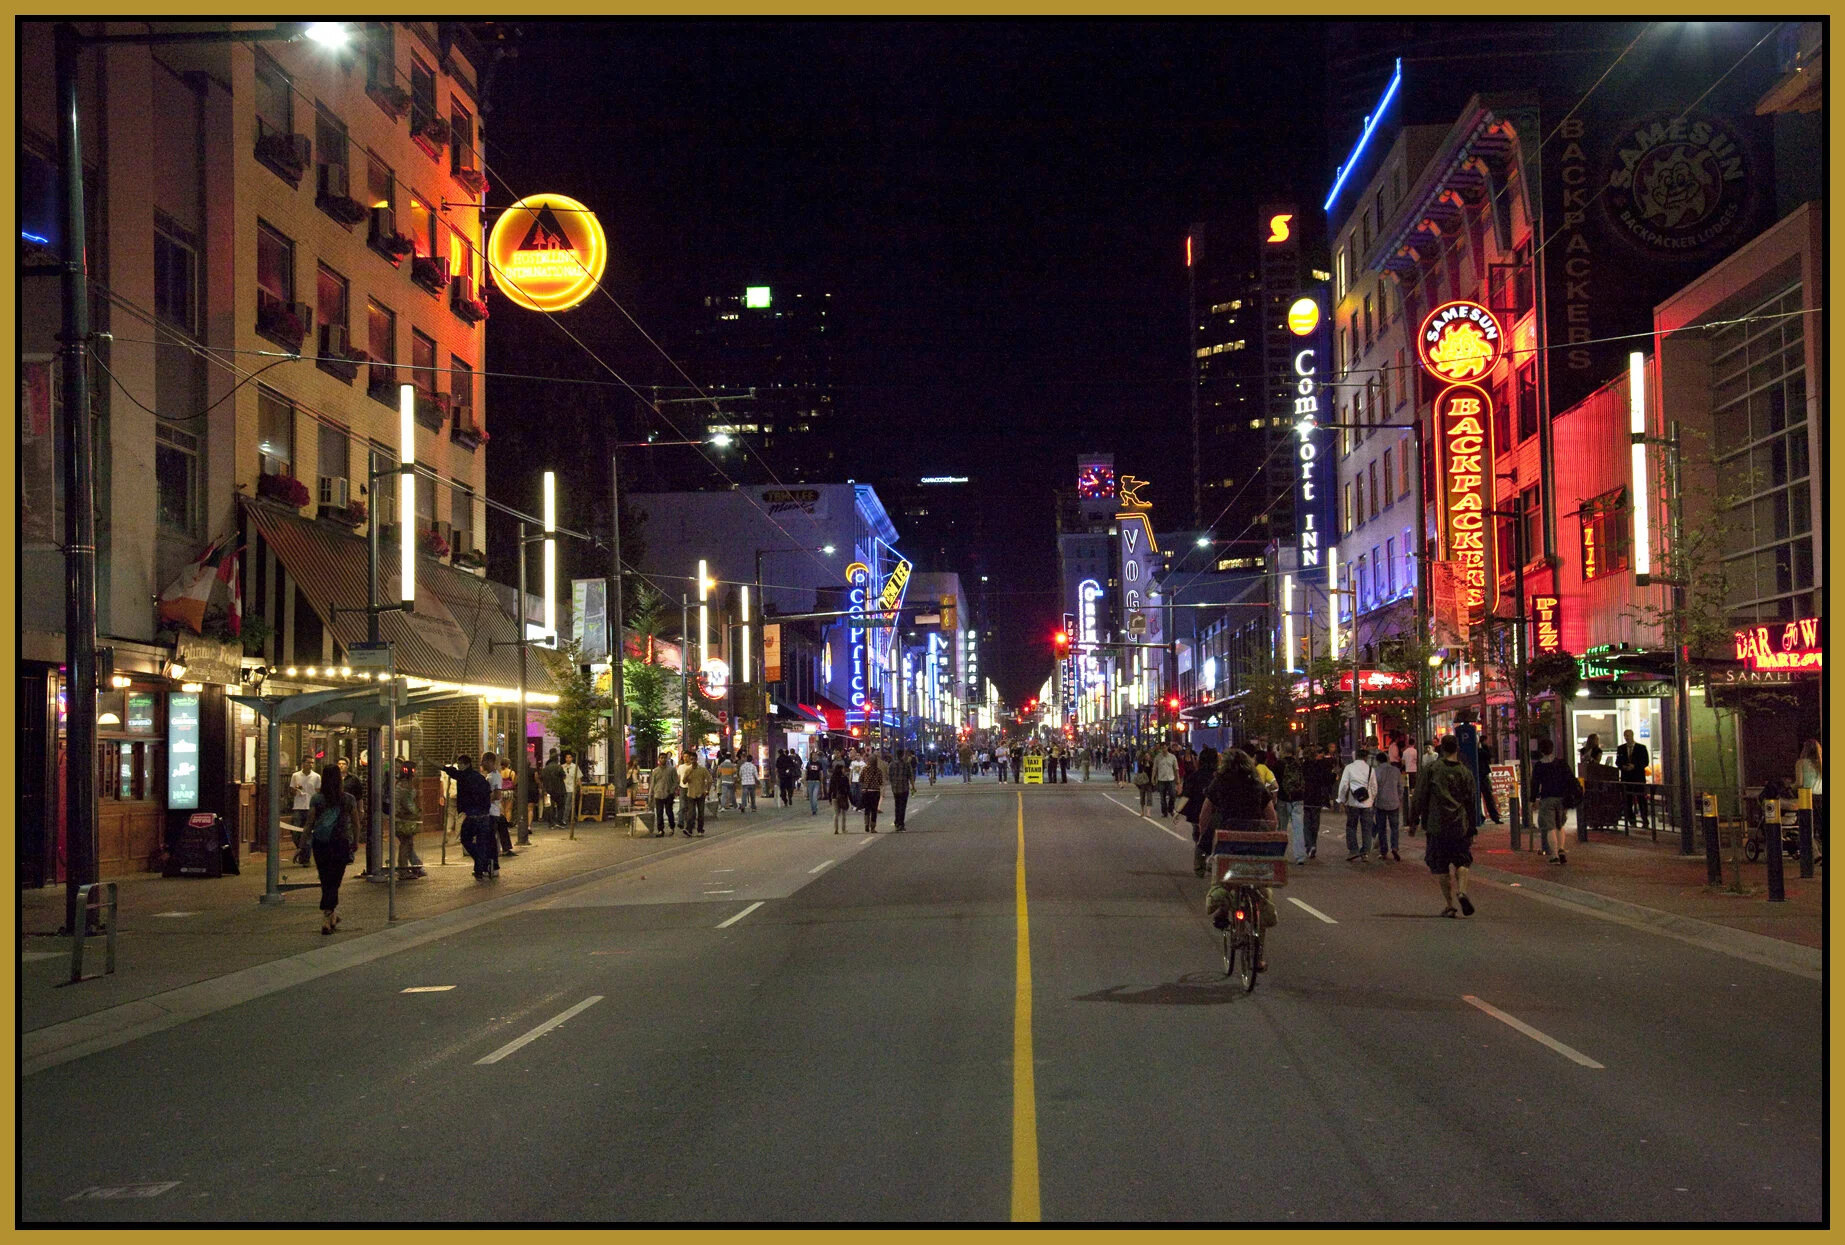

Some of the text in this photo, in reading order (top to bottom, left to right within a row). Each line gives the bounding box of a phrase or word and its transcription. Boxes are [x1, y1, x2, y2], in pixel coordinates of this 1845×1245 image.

[1610, 117, 1745, 189] SAMESUN
[1560, 119, 1592, 370] BACKPACKERS
[1620, 202, 1739, 249] BACKPACKER LODGES
[1426, 305, 1498, 342] SAMESUN
[1294, 349, 1319, 567] Comfort INN
[1122, 528, 1140, 661] VOGU
[966, 629, 978, 685] SEARS
[1726, 669, 1802, 681] SANAFIR
[1606, 684, 1670, 695] SANAFIR
[1489, 770, 1511, 778] IZZA
